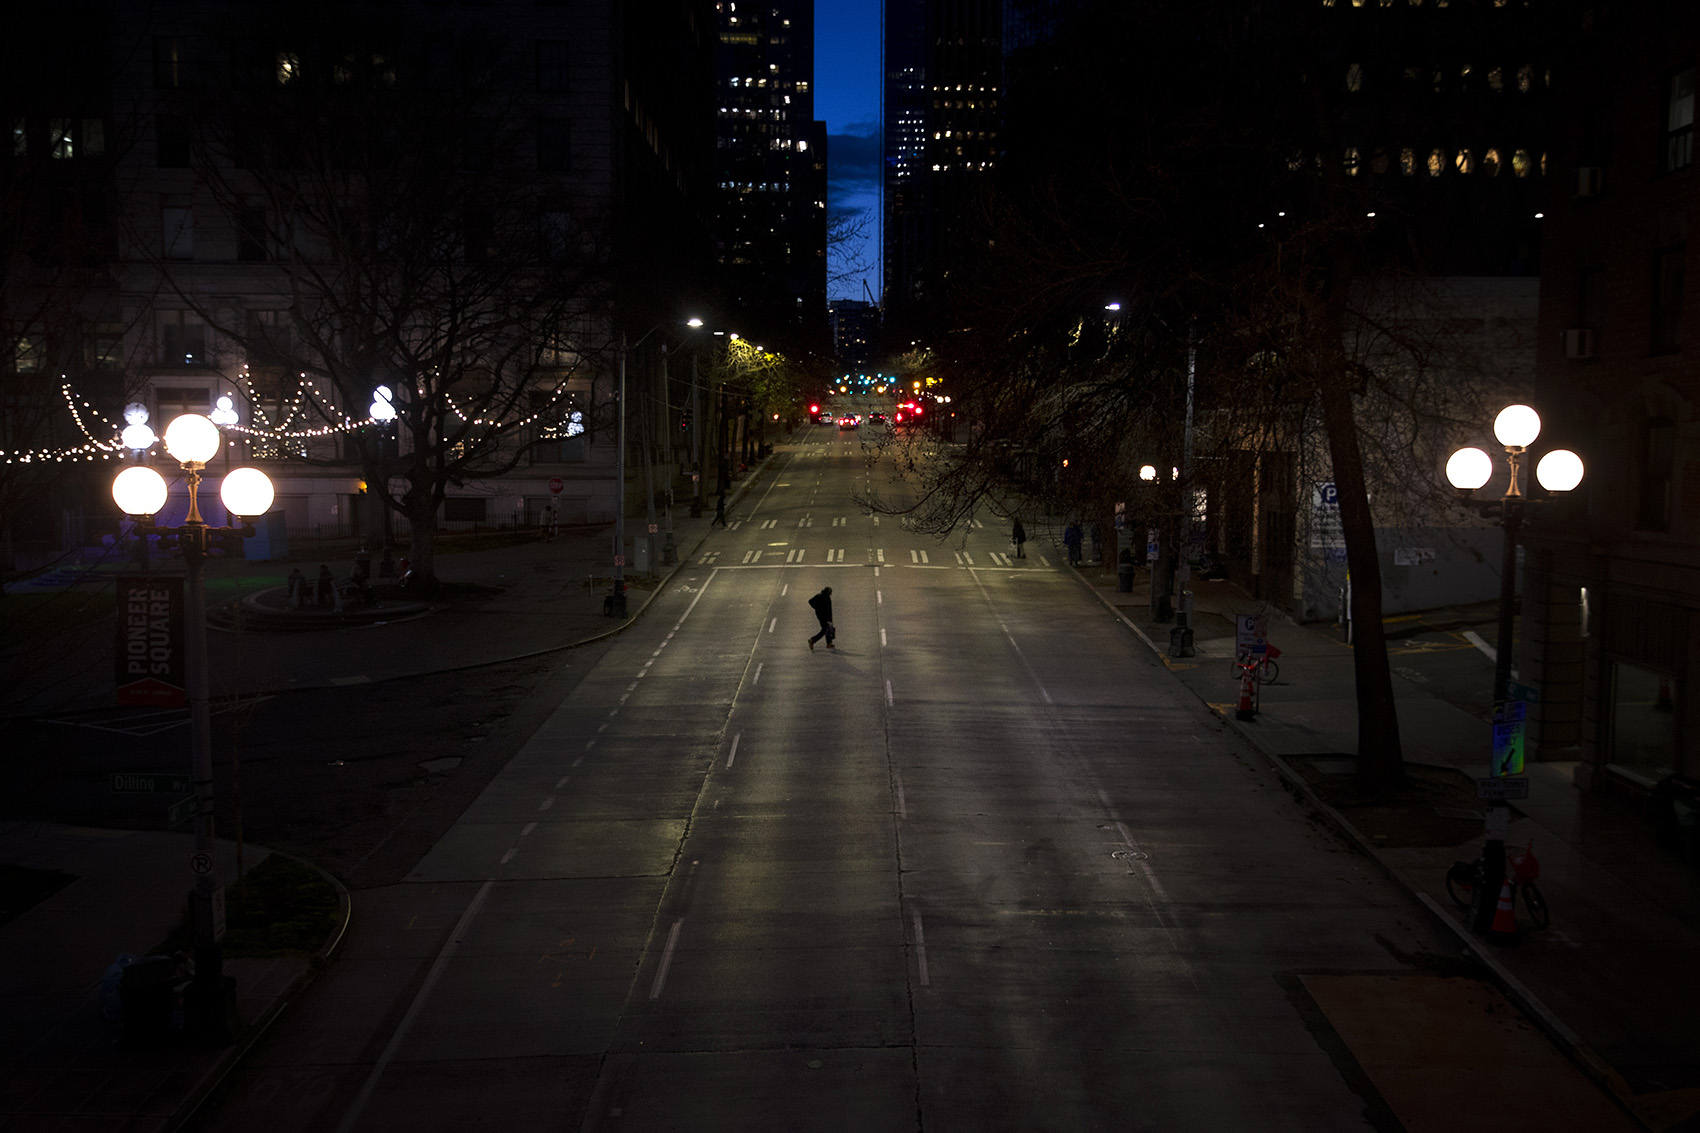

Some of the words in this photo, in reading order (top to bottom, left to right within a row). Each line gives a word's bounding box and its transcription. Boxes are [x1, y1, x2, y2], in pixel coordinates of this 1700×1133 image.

[127, 588, 148, 675] PIONEER
[150, 588, 172, 675] SQUARE
[1497, 722, 1521, 737] BUSES
[114, 775, 155, 793] Dilling
